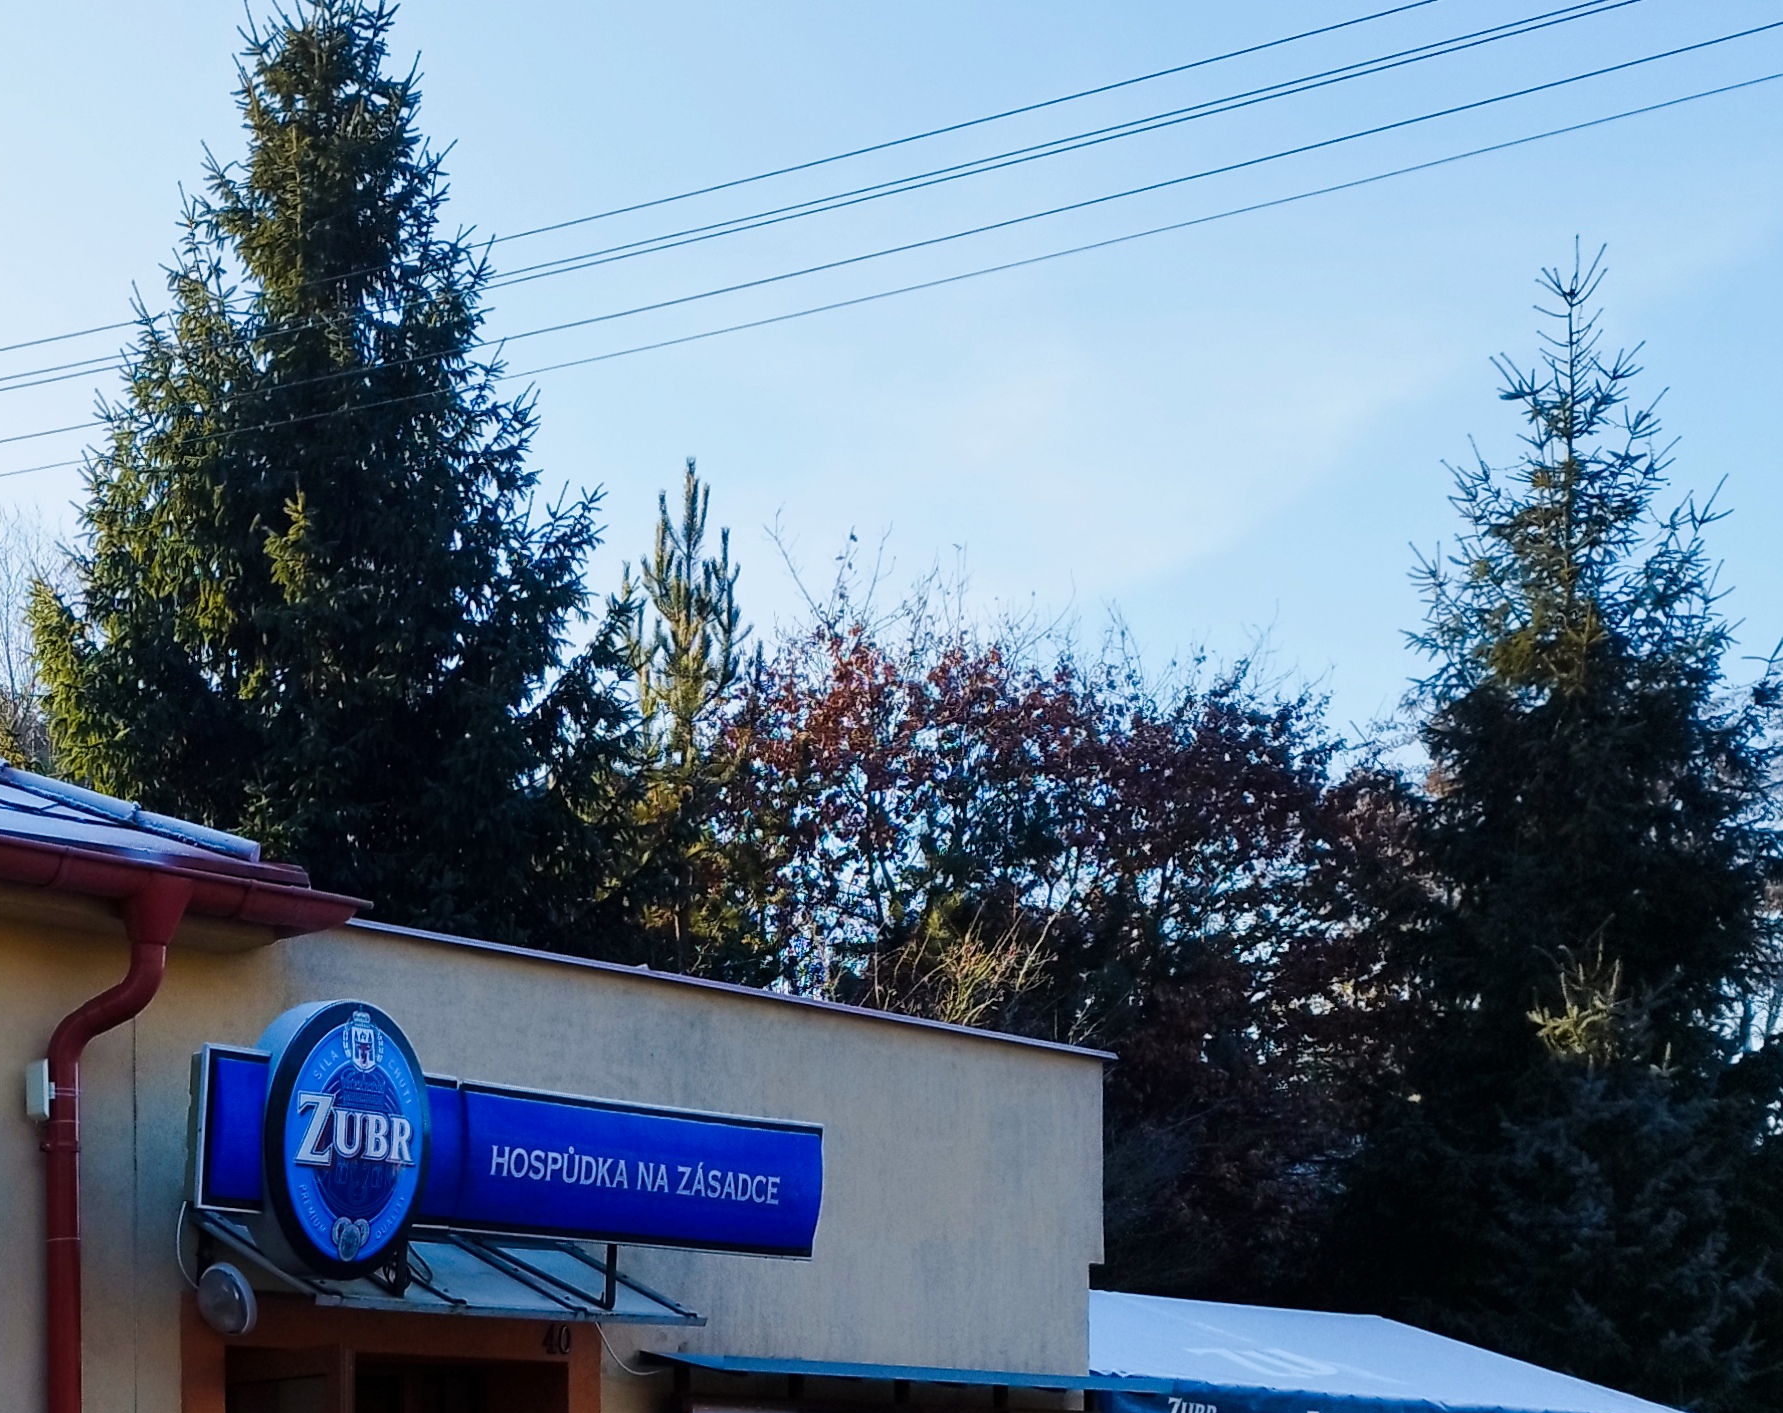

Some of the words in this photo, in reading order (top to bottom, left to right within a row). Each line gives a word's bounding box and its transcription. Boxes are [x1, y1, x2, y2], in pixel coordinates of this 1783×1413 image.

[294, 1090, 416, 1167] ZUBR
[490, 1145, 629, 1189] HOSPŮDKA
[636, 1161, 669, 1193] NA
[676, 1161, 781, 1205] ZÁSADCE
[542, 1323, 571, 1354] 40
